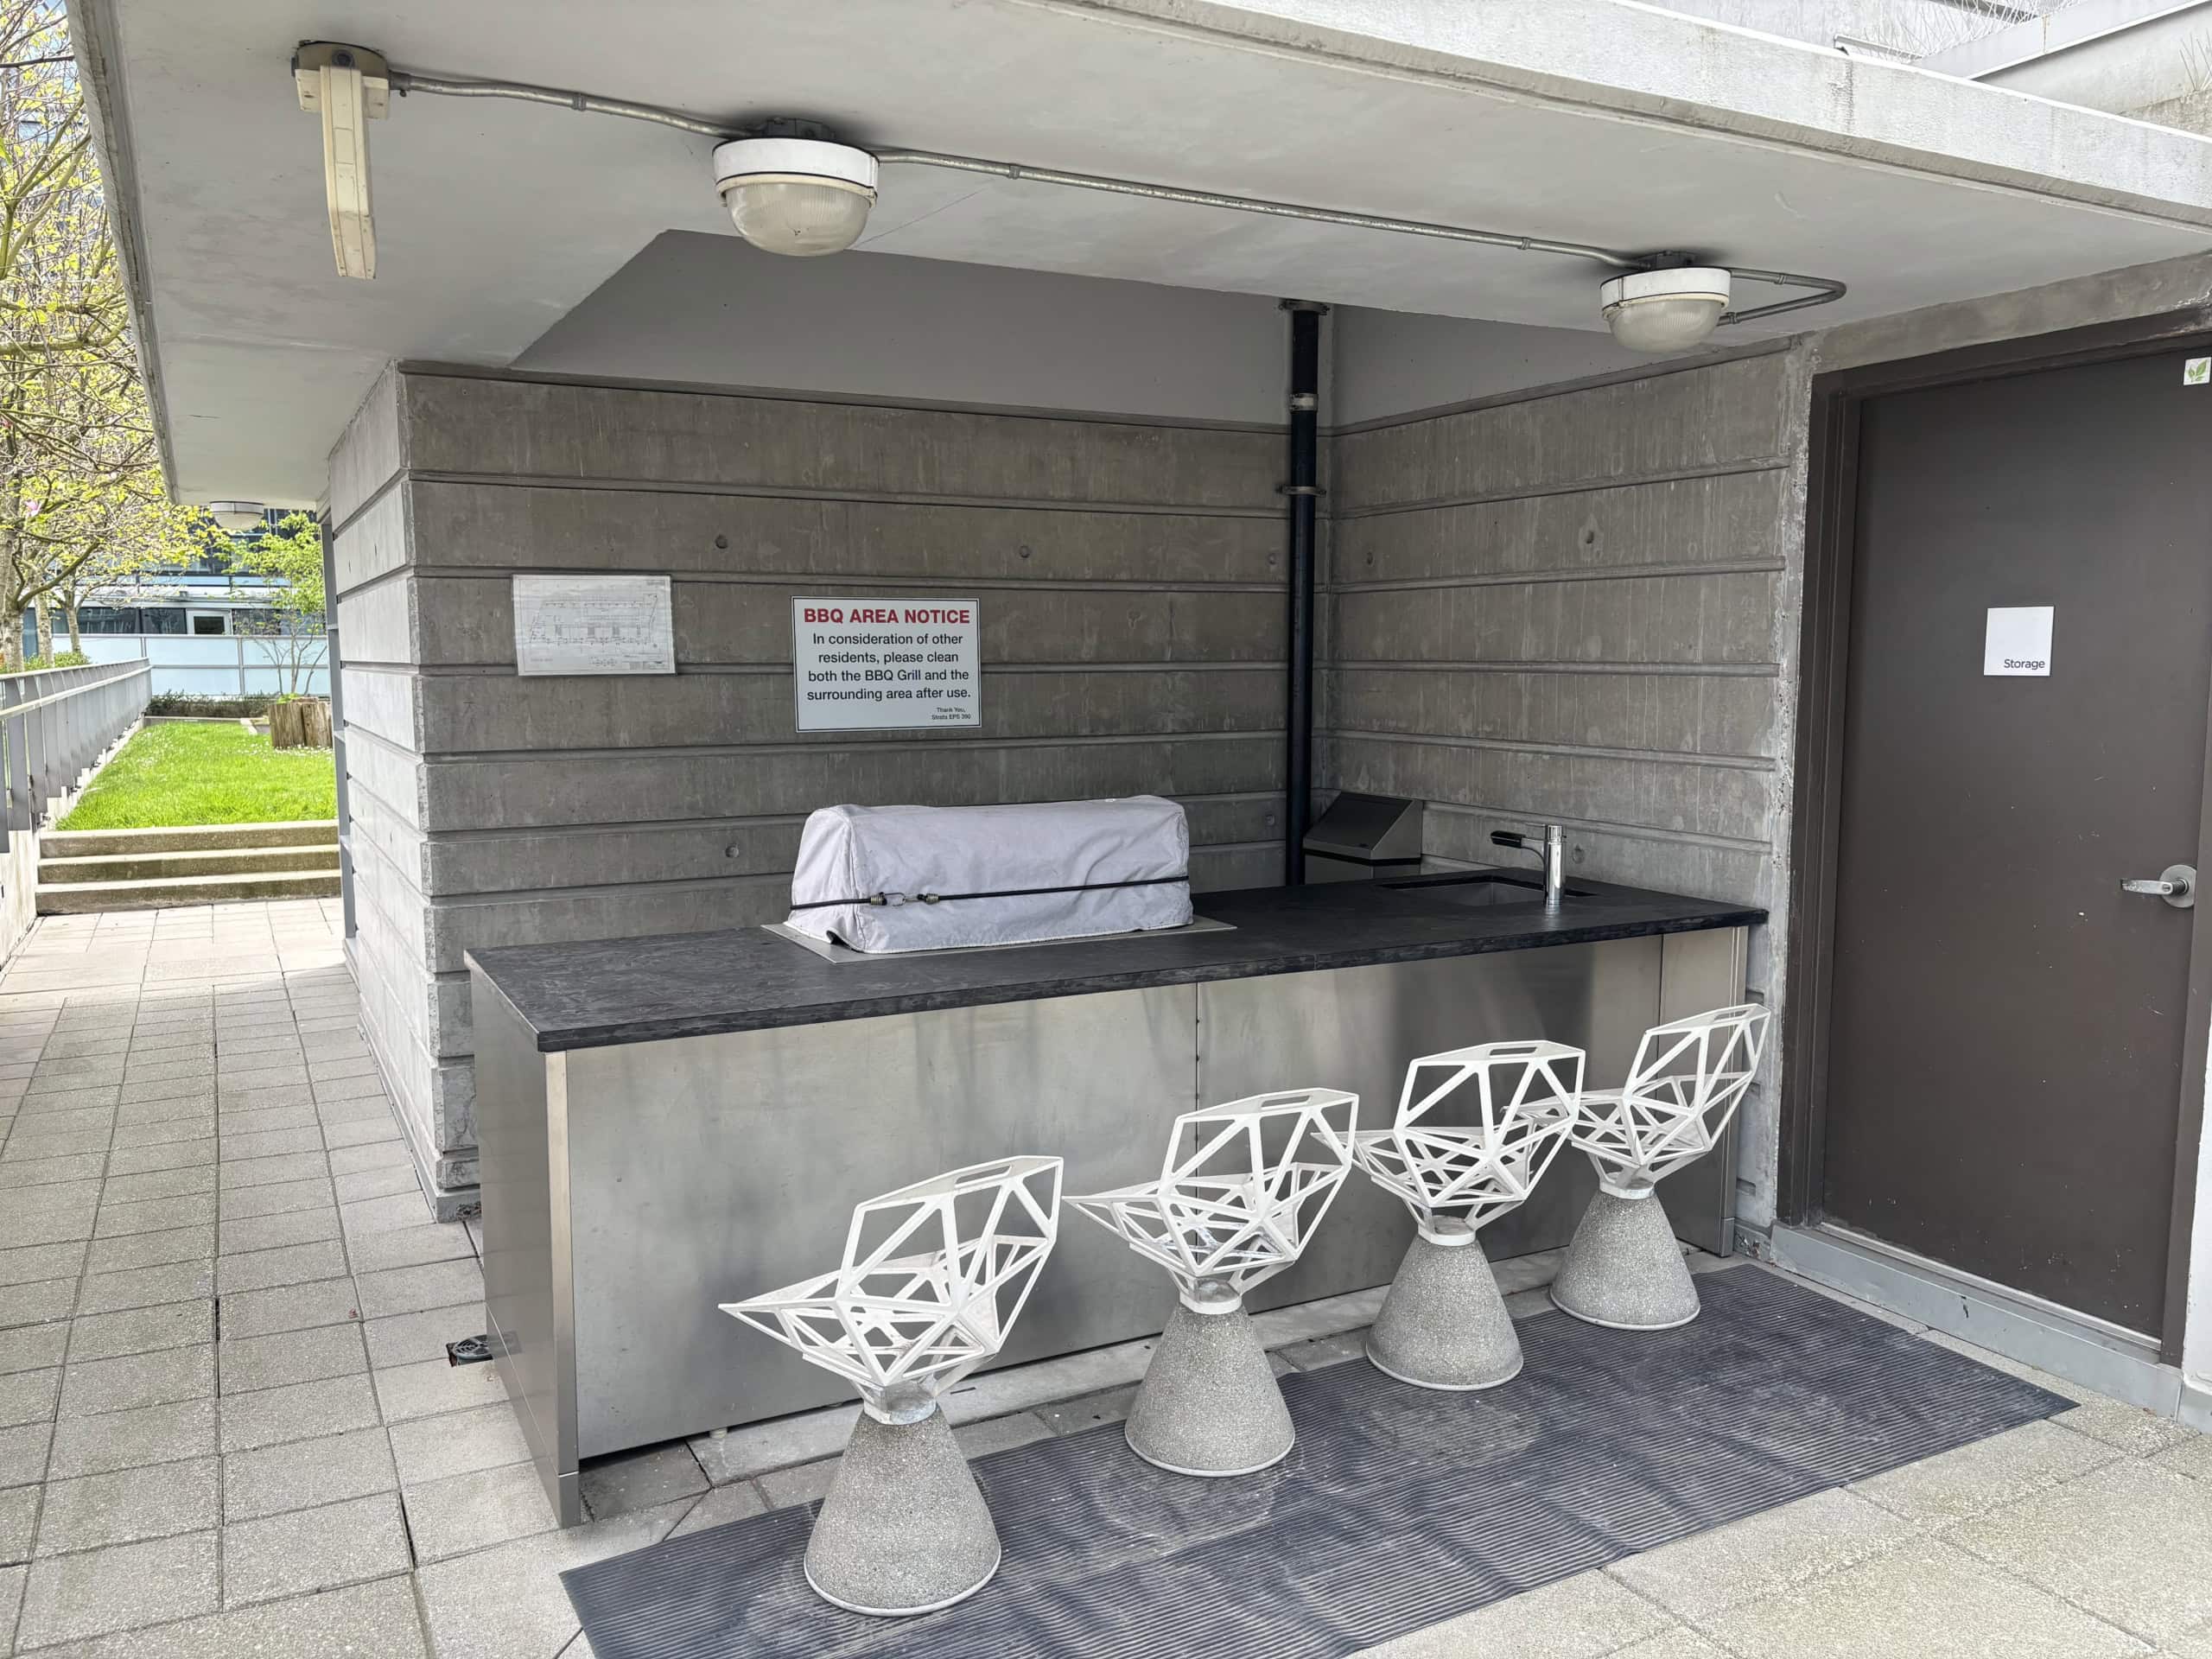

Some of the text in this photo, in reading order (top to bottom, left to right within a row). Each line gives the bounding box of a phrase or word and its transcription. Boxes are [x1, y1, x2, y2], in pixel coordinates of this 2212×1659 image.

[804, 608, 970, 624] BBQ AREA NOTICE
[813, 633, 963, 644] In consideration of other
[818, 652, 958, 664] residents, please clean
[2004, 658, 2045, 671] Storage
[809, 669, 969, 681] both the BBQ Grill and the
[807, 689, 882, 701] surrounding
[916, 688, 943, 698] after
[947, 689, 970, 698] use.
